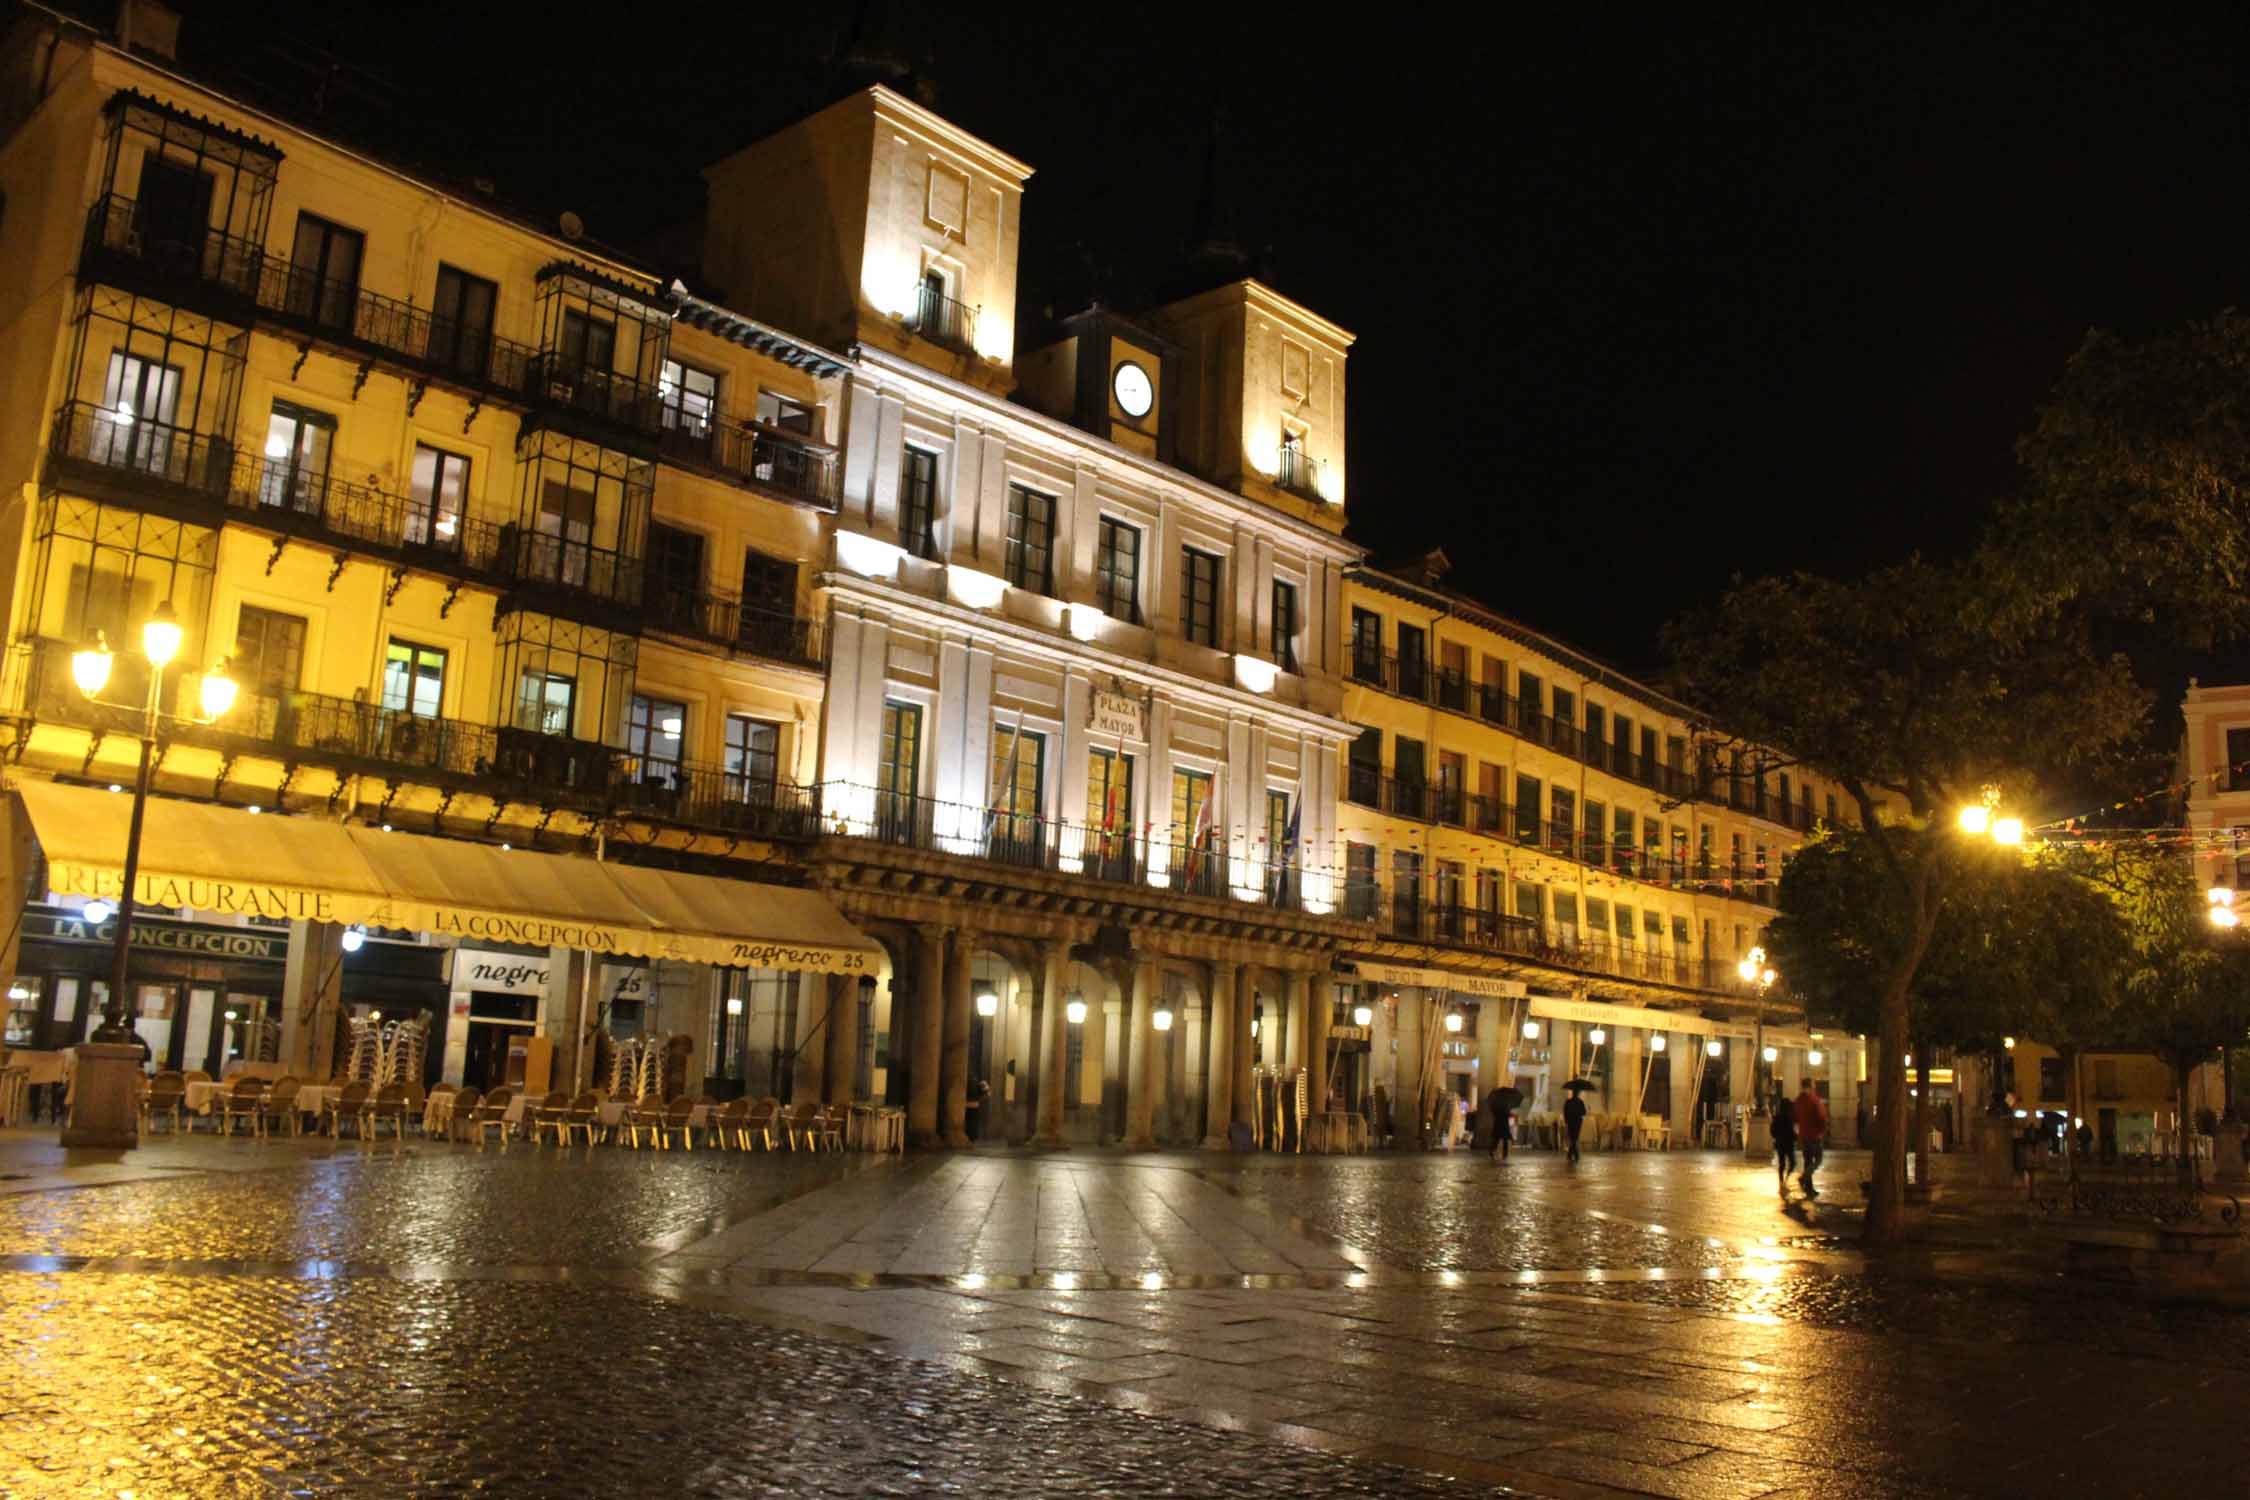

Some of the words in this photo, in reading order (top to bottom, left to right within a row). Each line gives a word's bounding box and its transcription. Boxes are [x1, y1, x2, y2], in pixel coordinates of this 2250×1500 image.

[1100, 696, 1136, 717] PLAZA
[1100, 716, 1135, 736] MAYOR
[53, 920, 87, 940] LA
[435, 911, 463, 933] LA
[469, 915, 617, 950] CONCEPCIÓN
[732, 943, 832, 966] negresco
[843, 953, 864, 969] 25
